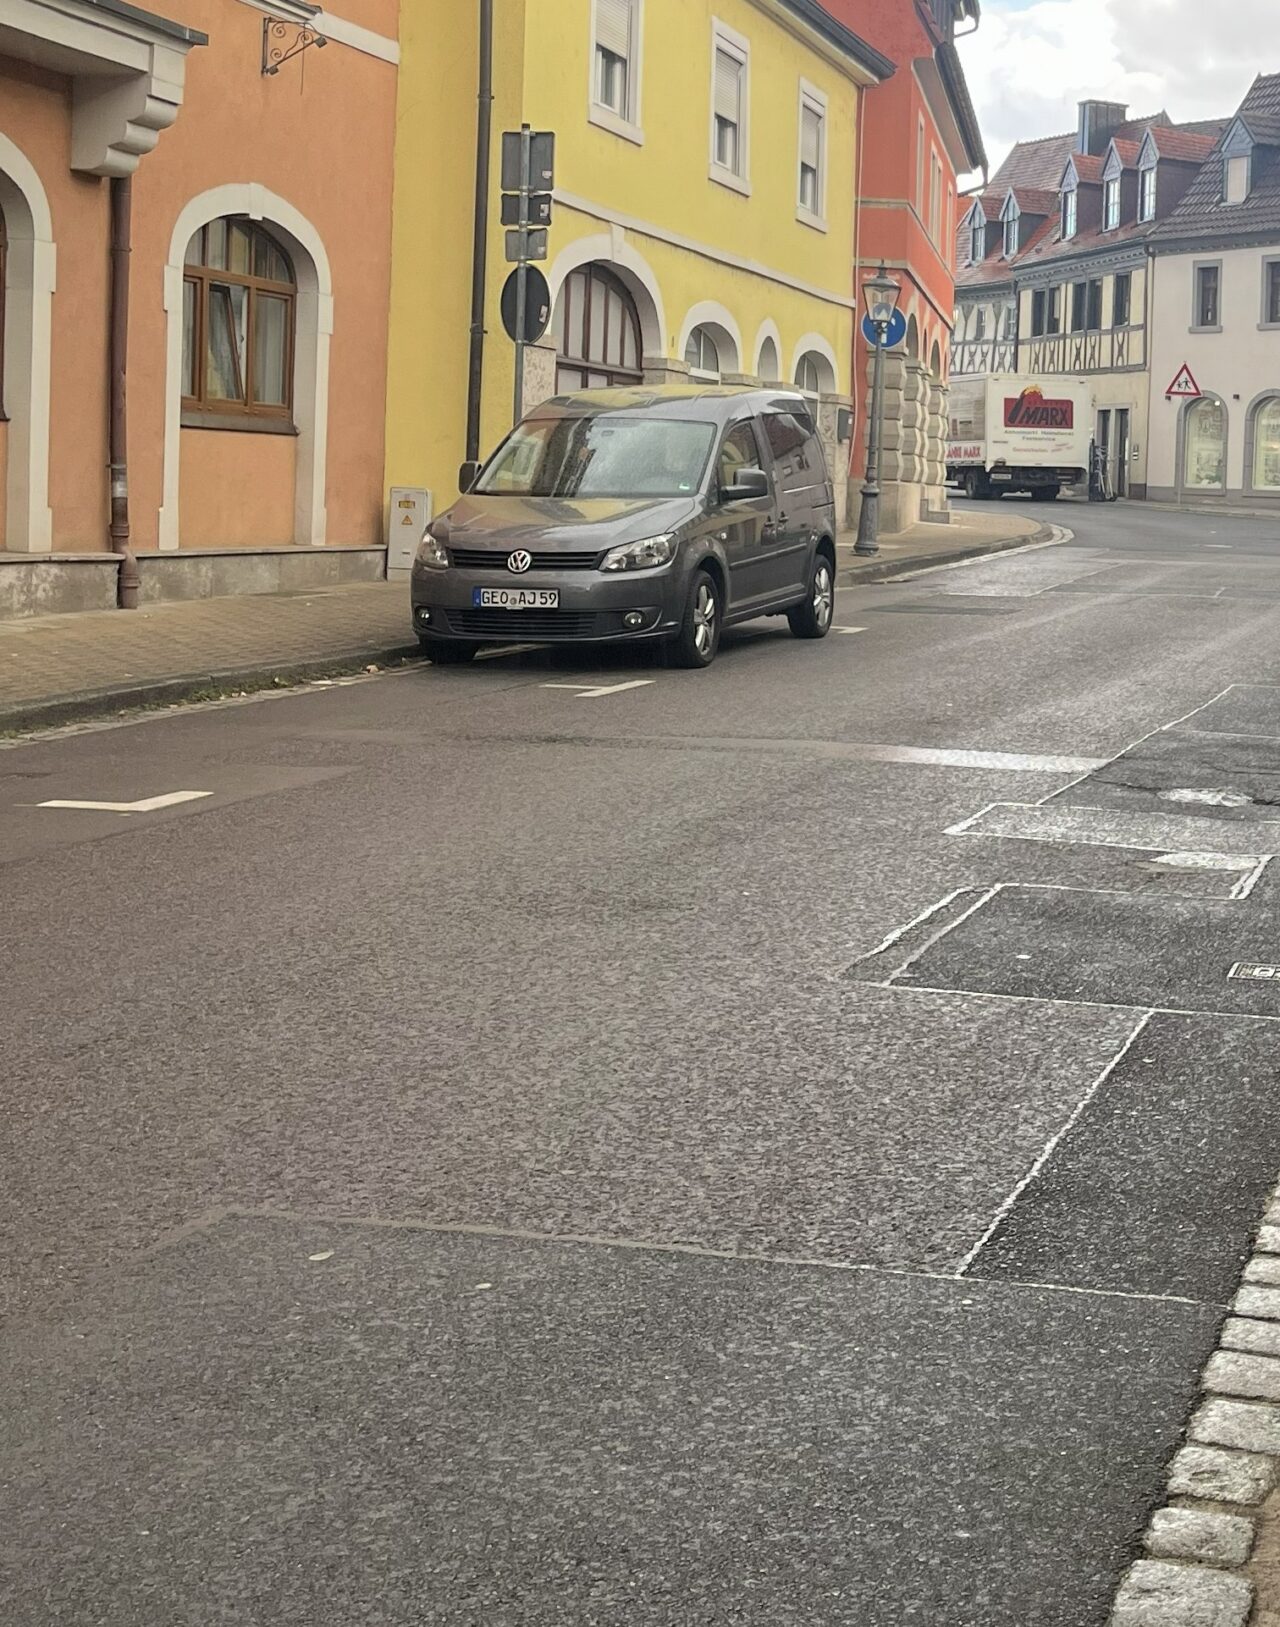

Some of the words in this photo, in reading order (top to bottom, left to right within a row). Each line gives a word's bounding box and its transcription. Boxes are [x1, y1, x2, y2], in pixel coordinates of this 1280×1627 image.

[1018, 406, 1069, 426] MARX
[963, 446, 981, 458] MARX
[482, 591, 509, 604] GEO
[518, 592, 536, 605] AJ
[539, 592, 557, 605] 59
